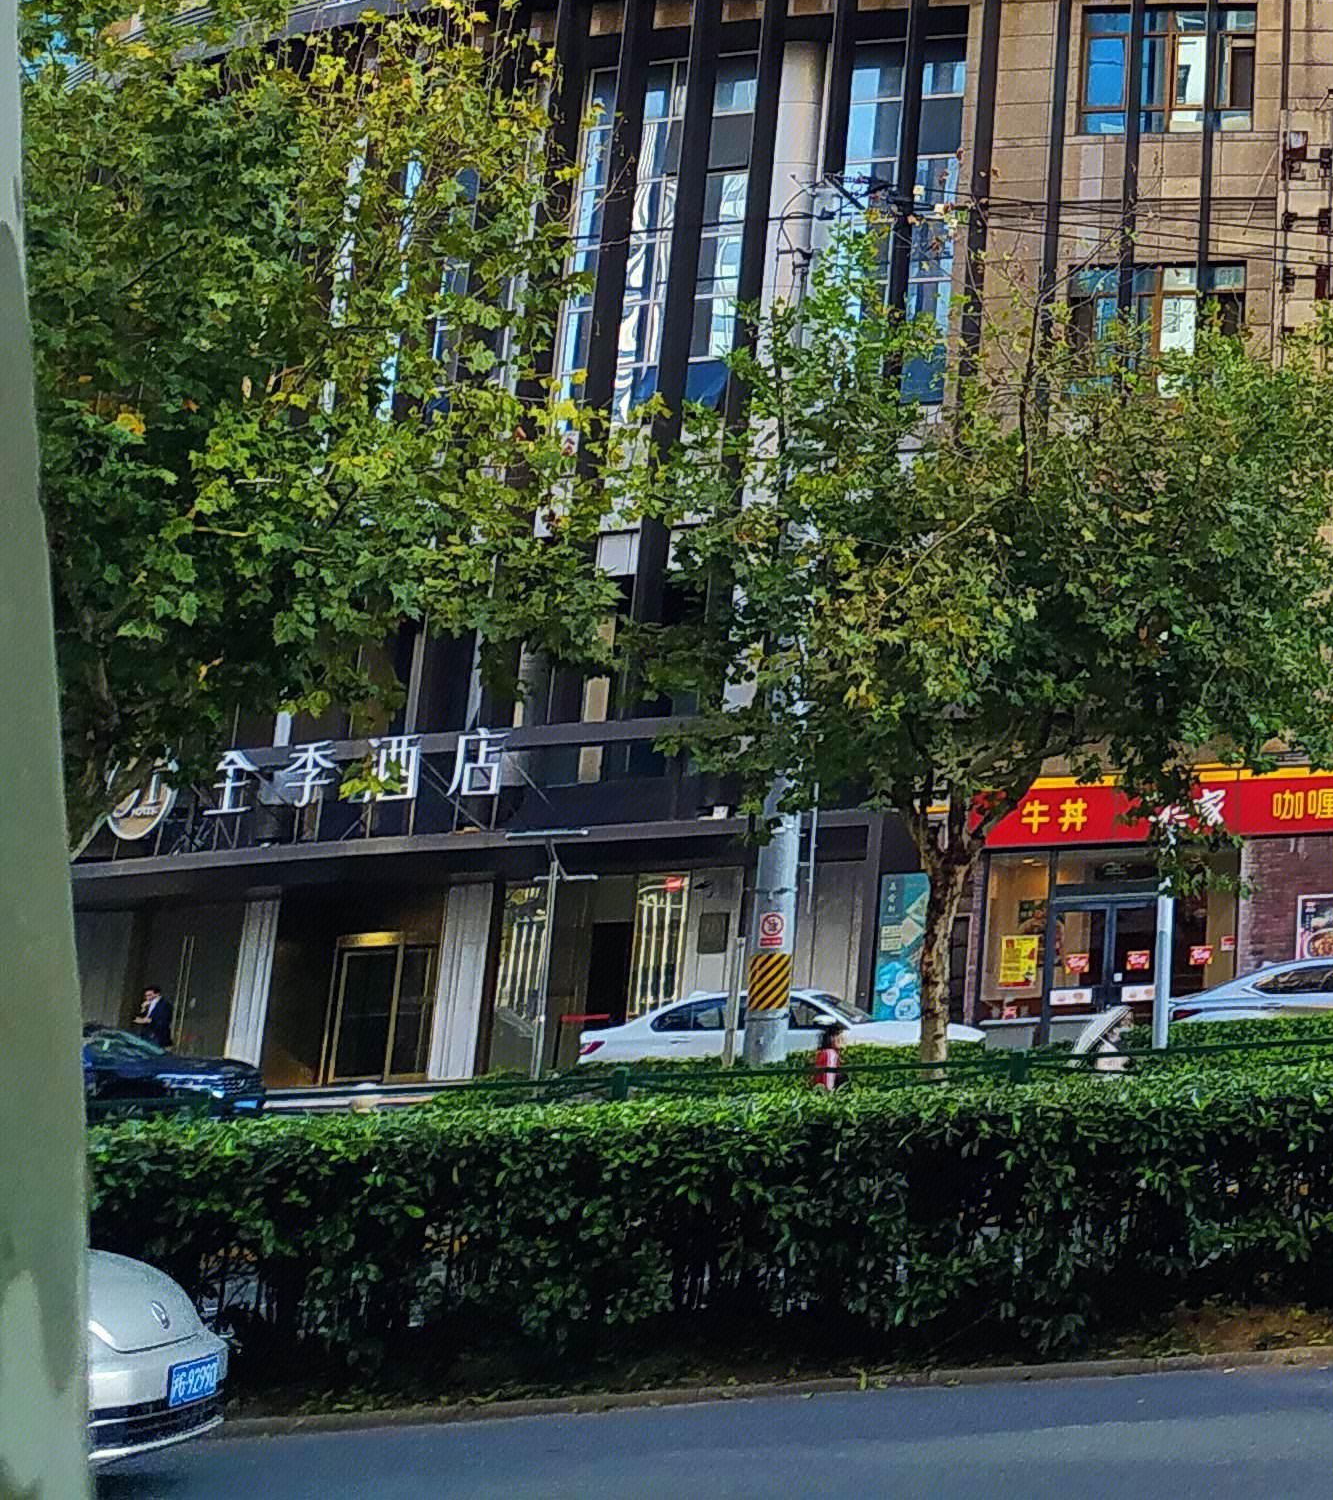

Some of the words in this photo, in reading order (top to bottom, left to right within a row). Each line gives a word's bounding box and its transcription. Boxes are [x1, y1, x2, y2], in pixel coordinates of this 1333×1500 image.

[203, 727, 510, 816] 全季酒店
[1021, 797, 1088, 835] 牛丼
